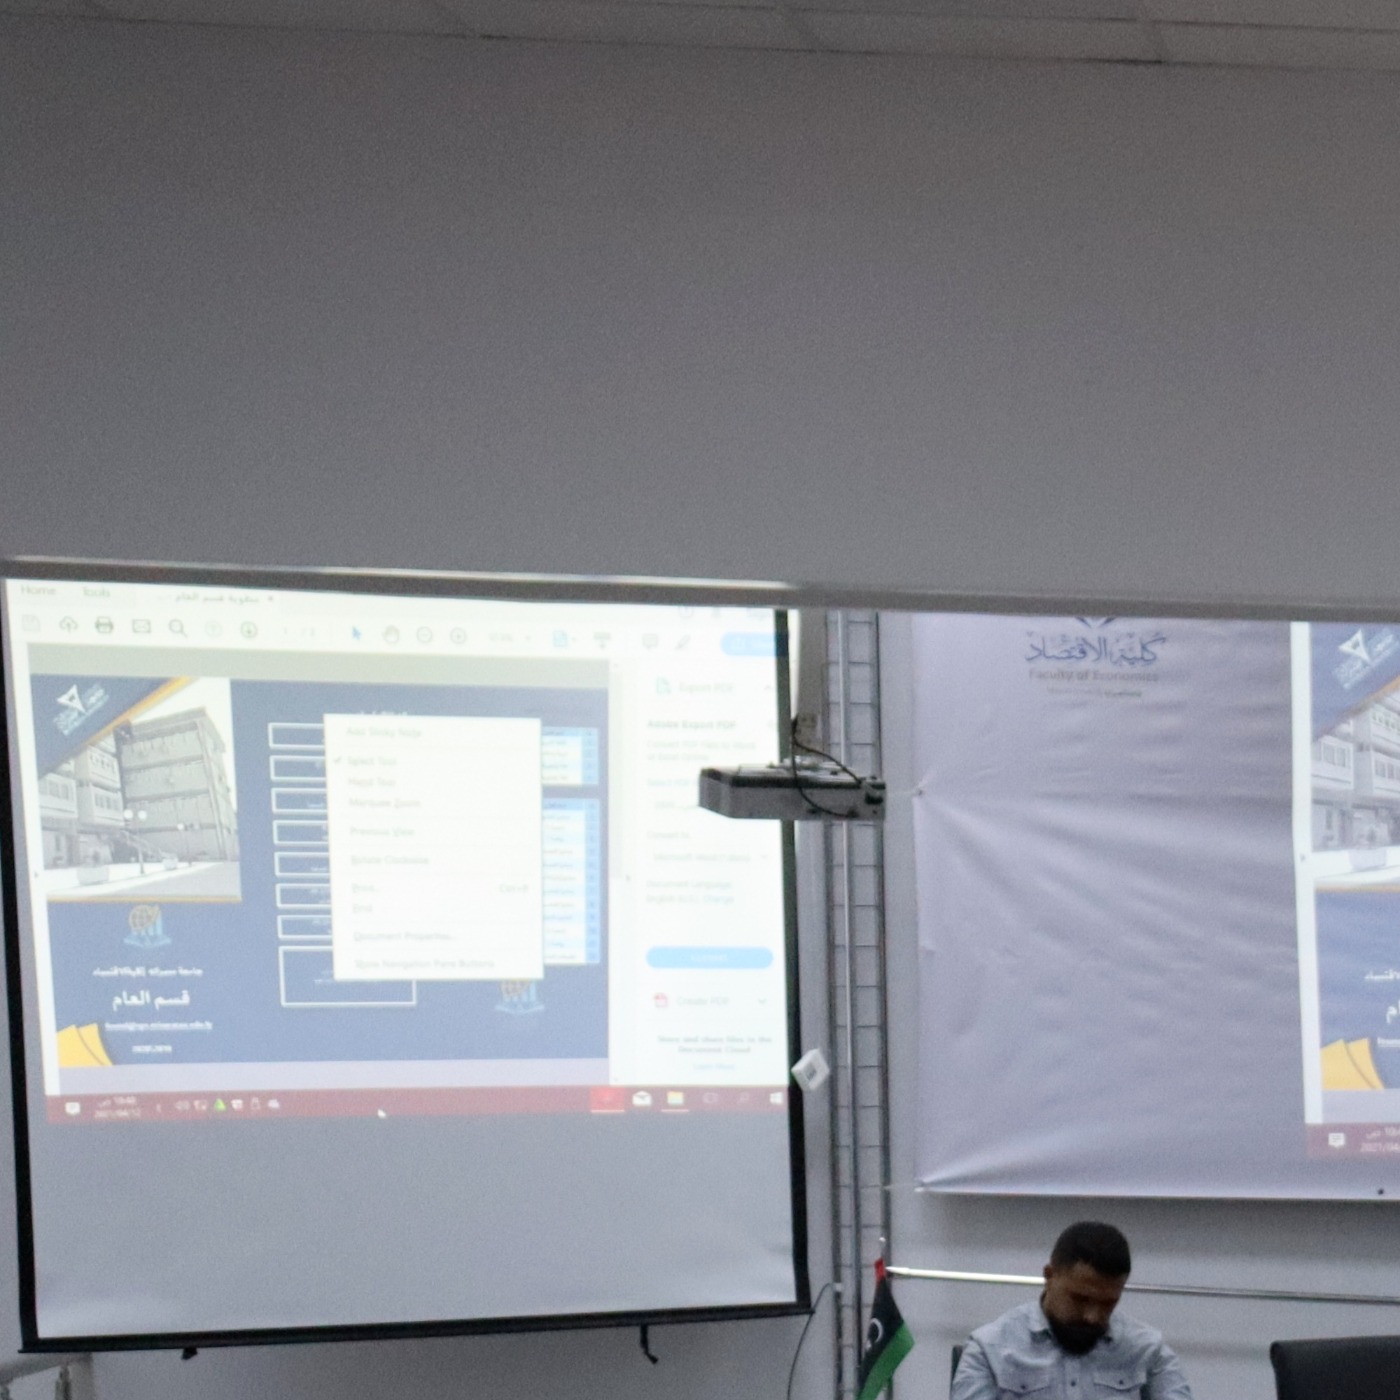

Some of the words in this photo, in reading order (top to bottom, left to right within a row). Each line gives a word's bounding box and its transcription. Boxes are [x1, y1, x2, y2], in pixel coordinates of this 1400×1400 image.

[21, 585, 56, 597] Home
[83, 587, 110, 598] Tools
[647, 720, 679, 729] Adobe
[112, 990, 151, 1012] العام
[154, 990, 190, 1011] قسم
